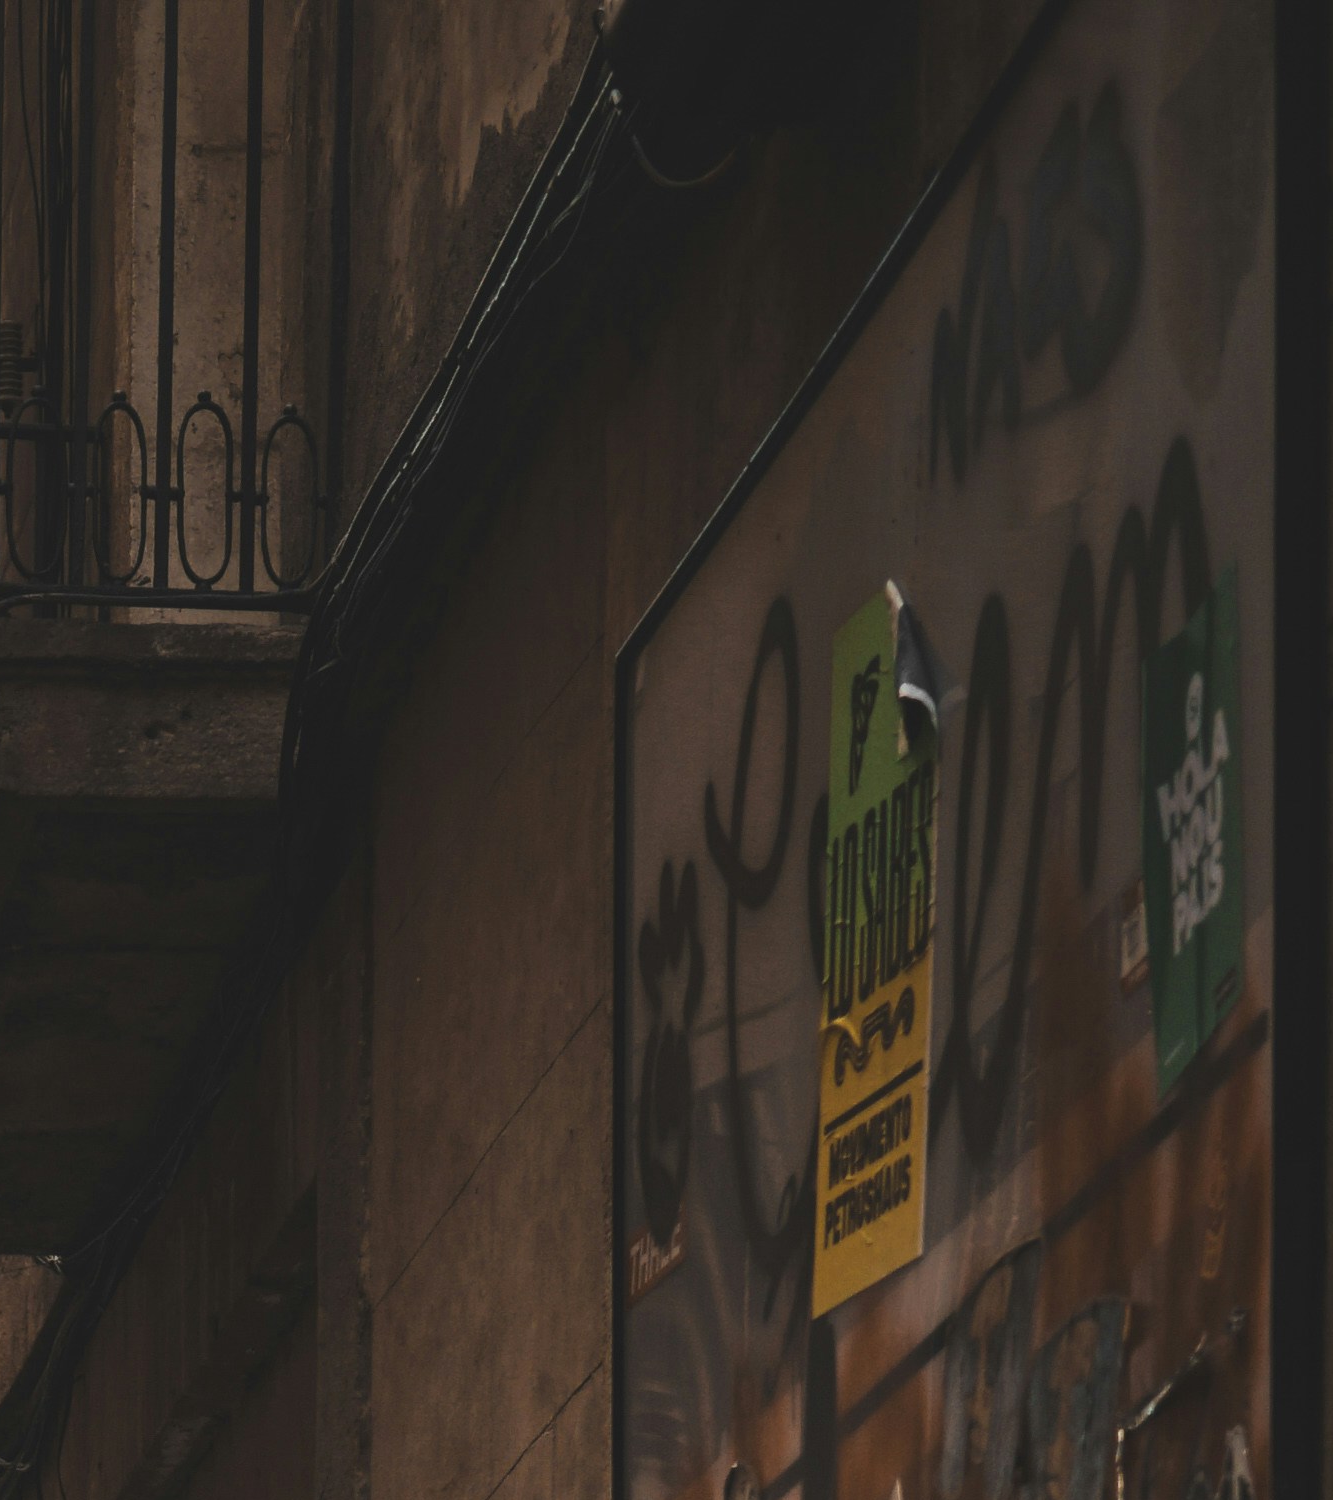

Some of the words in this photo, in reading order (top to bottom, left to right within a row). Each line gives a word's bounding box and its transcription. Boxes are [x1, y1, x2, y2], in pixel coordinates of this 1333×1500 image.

[1157, 708, 1229, 842] HOLA
[1171, 773, 1223, 896] NOU
[827, 822, 859, 1020] LO
[856, 760, 933, 1004] SABES
[824, 1153, 911, 1250] PETRUSHAUS
[829, 1093, 912, 1191] MOVIMIENTO
